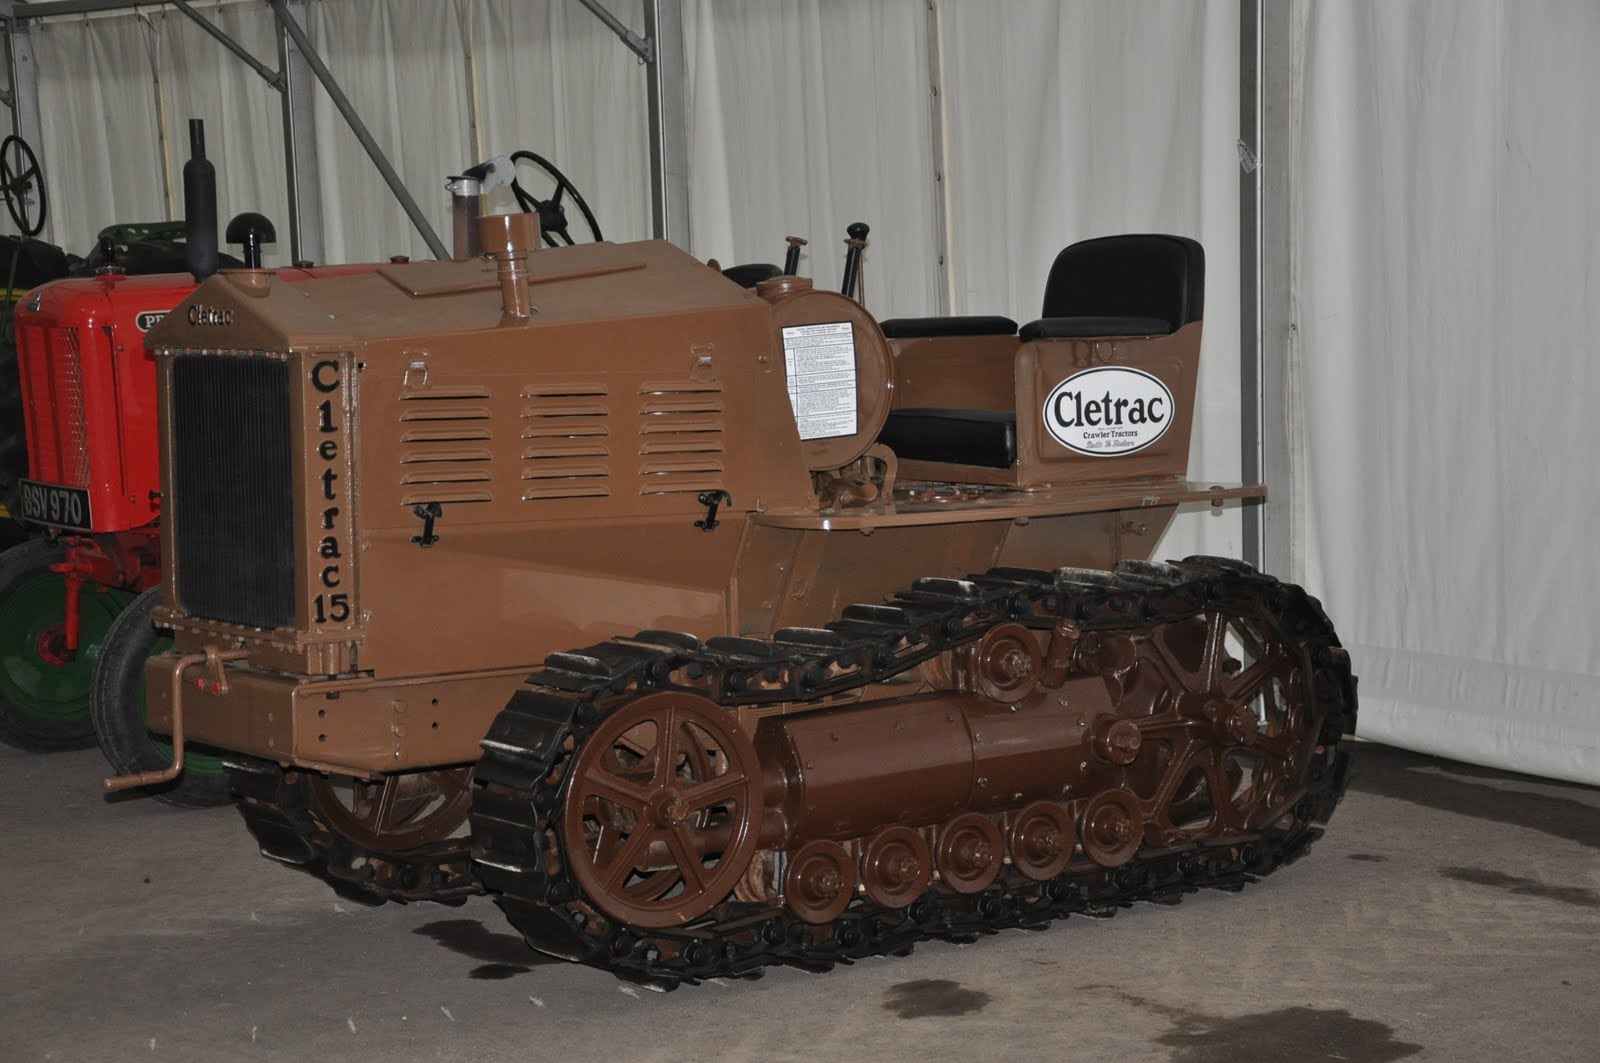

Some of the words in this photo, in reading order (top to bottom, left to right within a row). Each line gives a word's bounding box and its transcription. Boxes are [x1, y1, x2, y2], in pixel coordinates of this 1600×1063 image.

[188, 304, 233, 326] Cletrac
[1054, 390, 1165, 427] Cletrac
[1083, 431, 1110, 439] Crawler
[1111, 430, 1138, 438] Tractors
[311, 360, 341, 588] Cletrac
[23, 484, 48, 520] BSV
[50, 489, 82, 525] 970
[314, 593, 350, 623] 15
